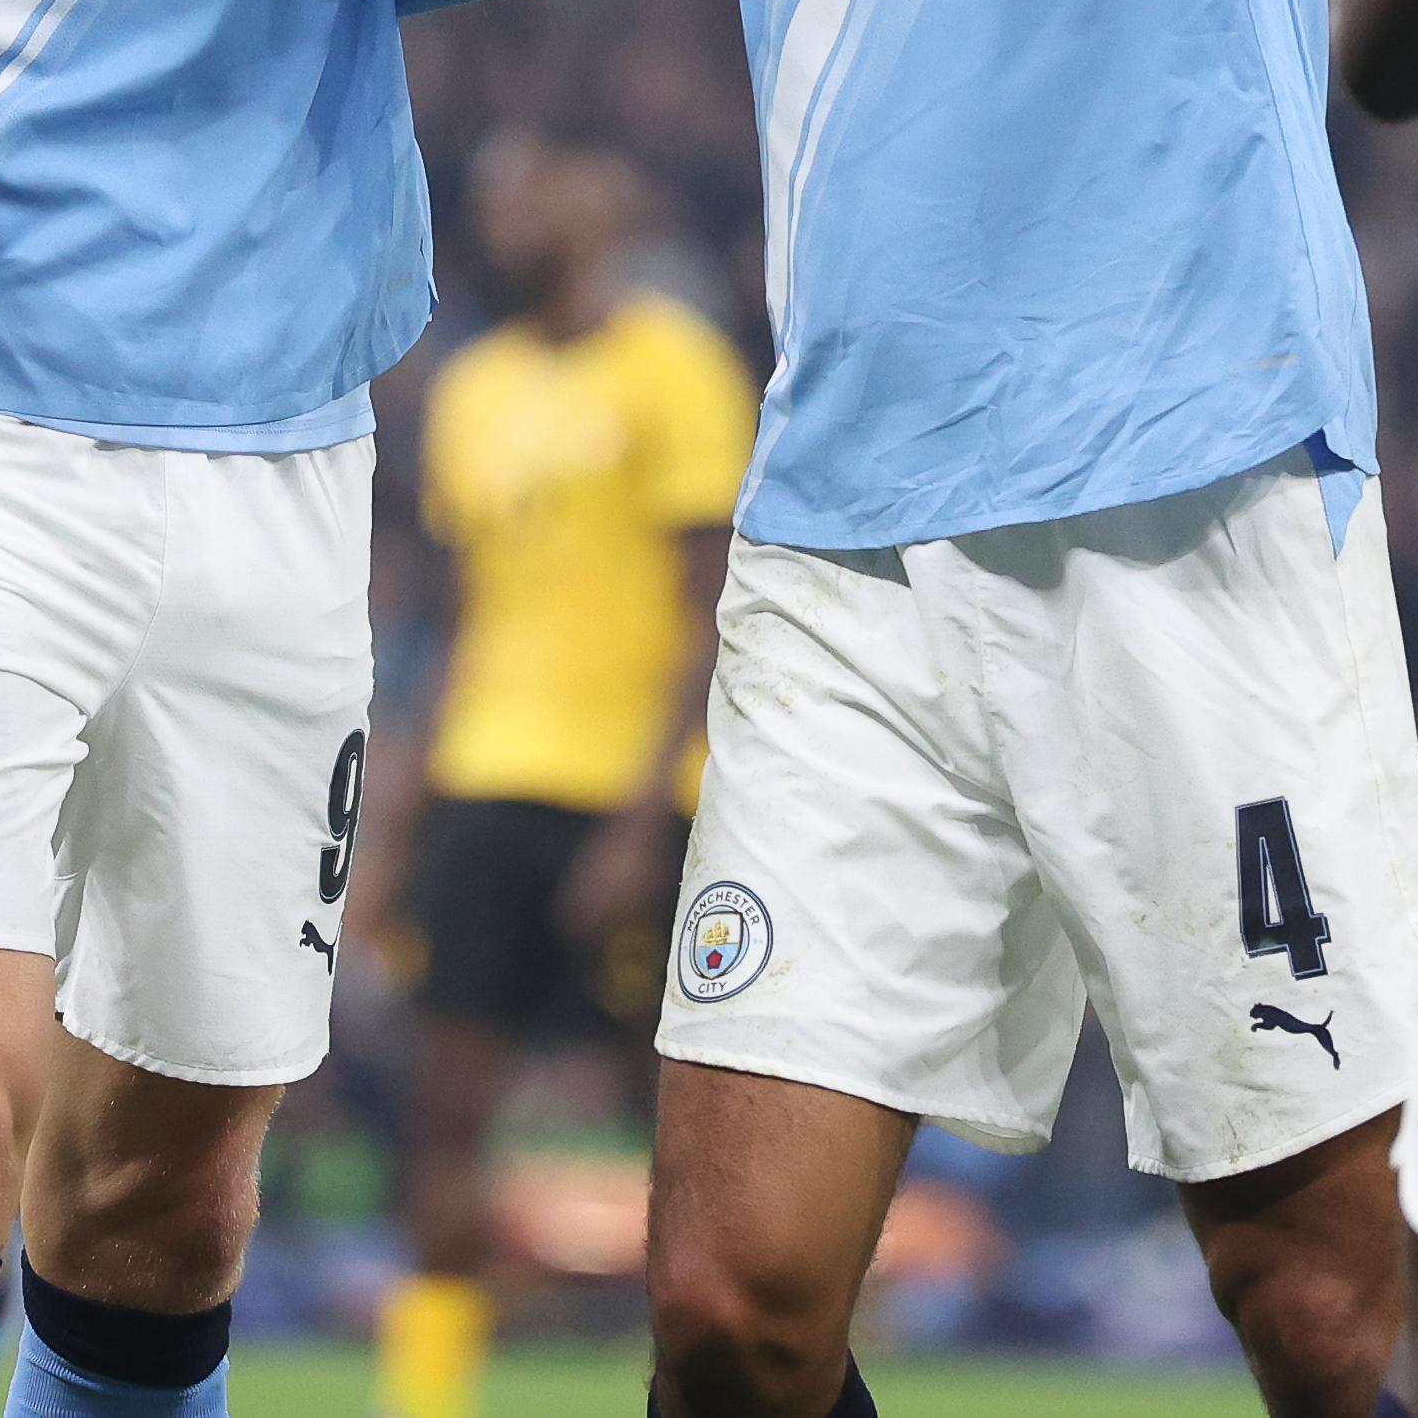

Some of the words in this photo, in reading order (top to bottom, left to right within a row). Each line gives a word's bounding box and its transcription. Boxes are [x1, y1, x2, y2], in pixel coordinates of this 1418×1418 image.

[319, 728, 365, 904] 9
[687, 891, 761, 932] MANCHESTER
[1235, 795, 1332, 981] 4
[698, 982, 727, 994] CITY
